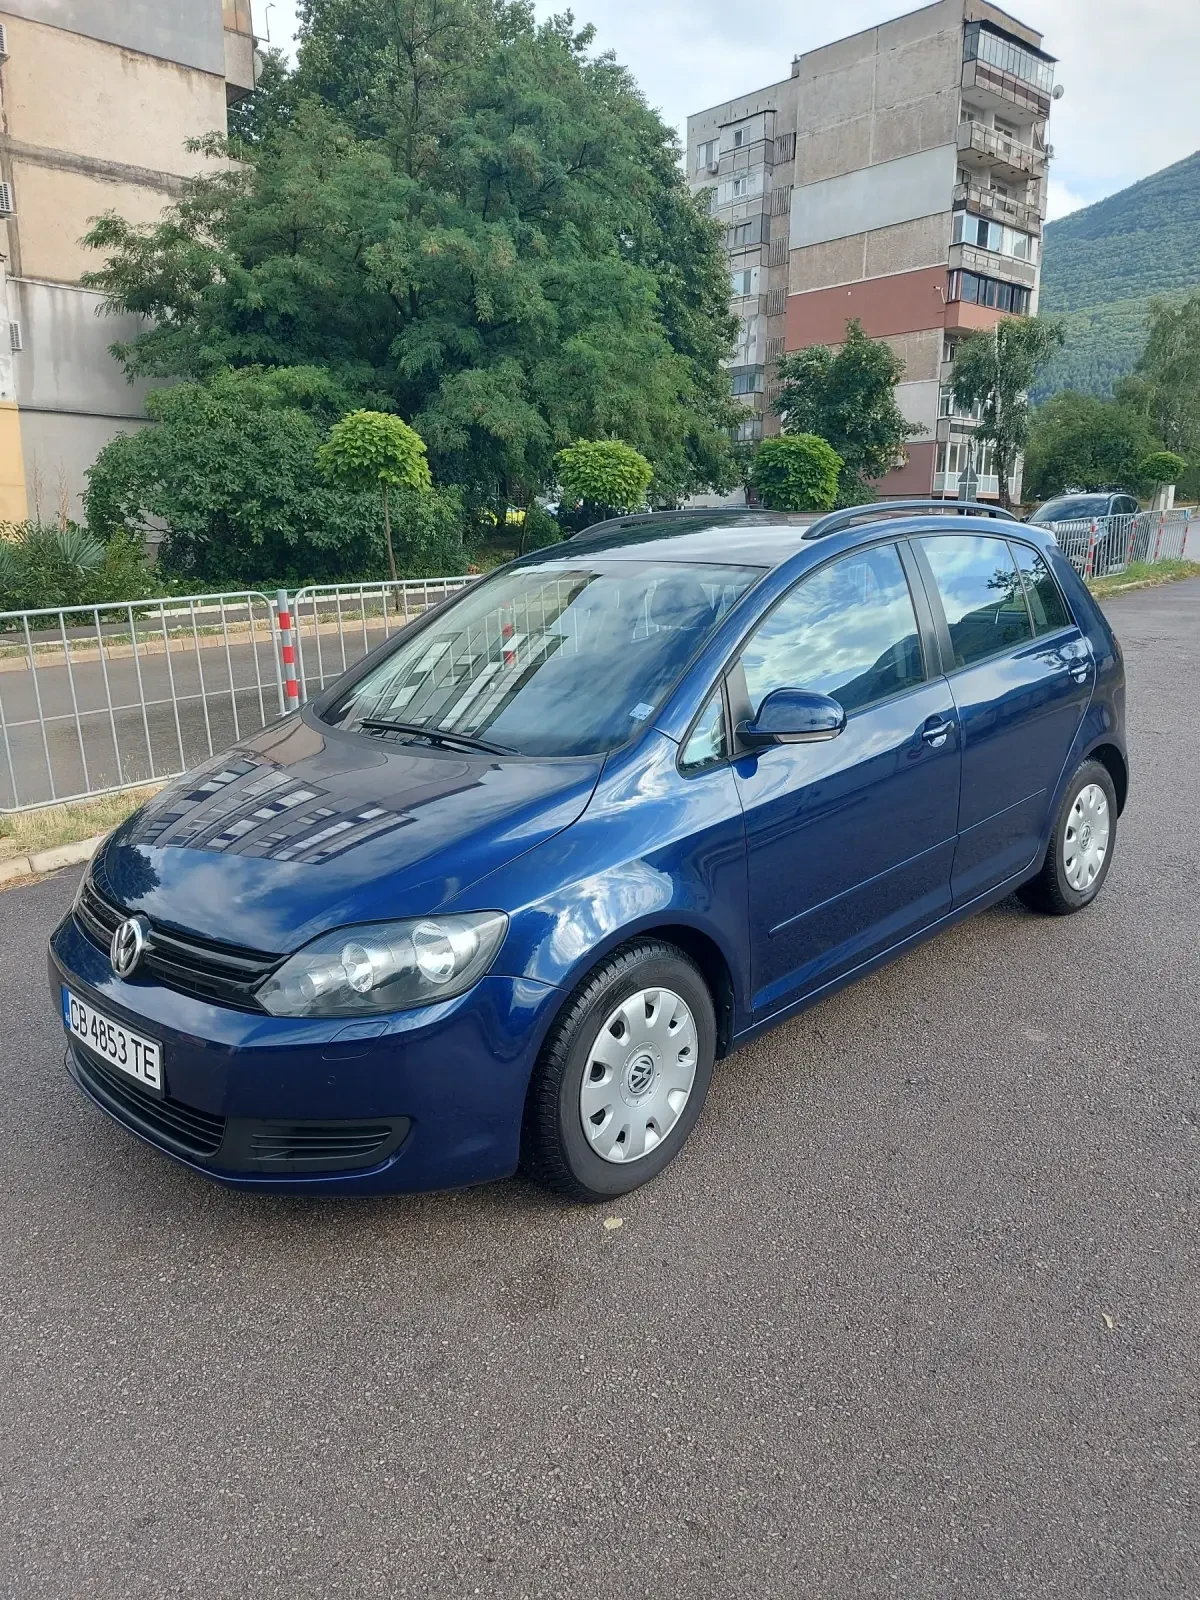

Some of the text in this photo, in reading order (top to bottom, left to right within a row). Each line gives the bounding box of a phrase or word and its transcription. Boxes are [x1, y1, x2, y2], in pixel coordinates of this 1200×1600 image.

[70, 999, 157, 1083] CB 4853 TE
